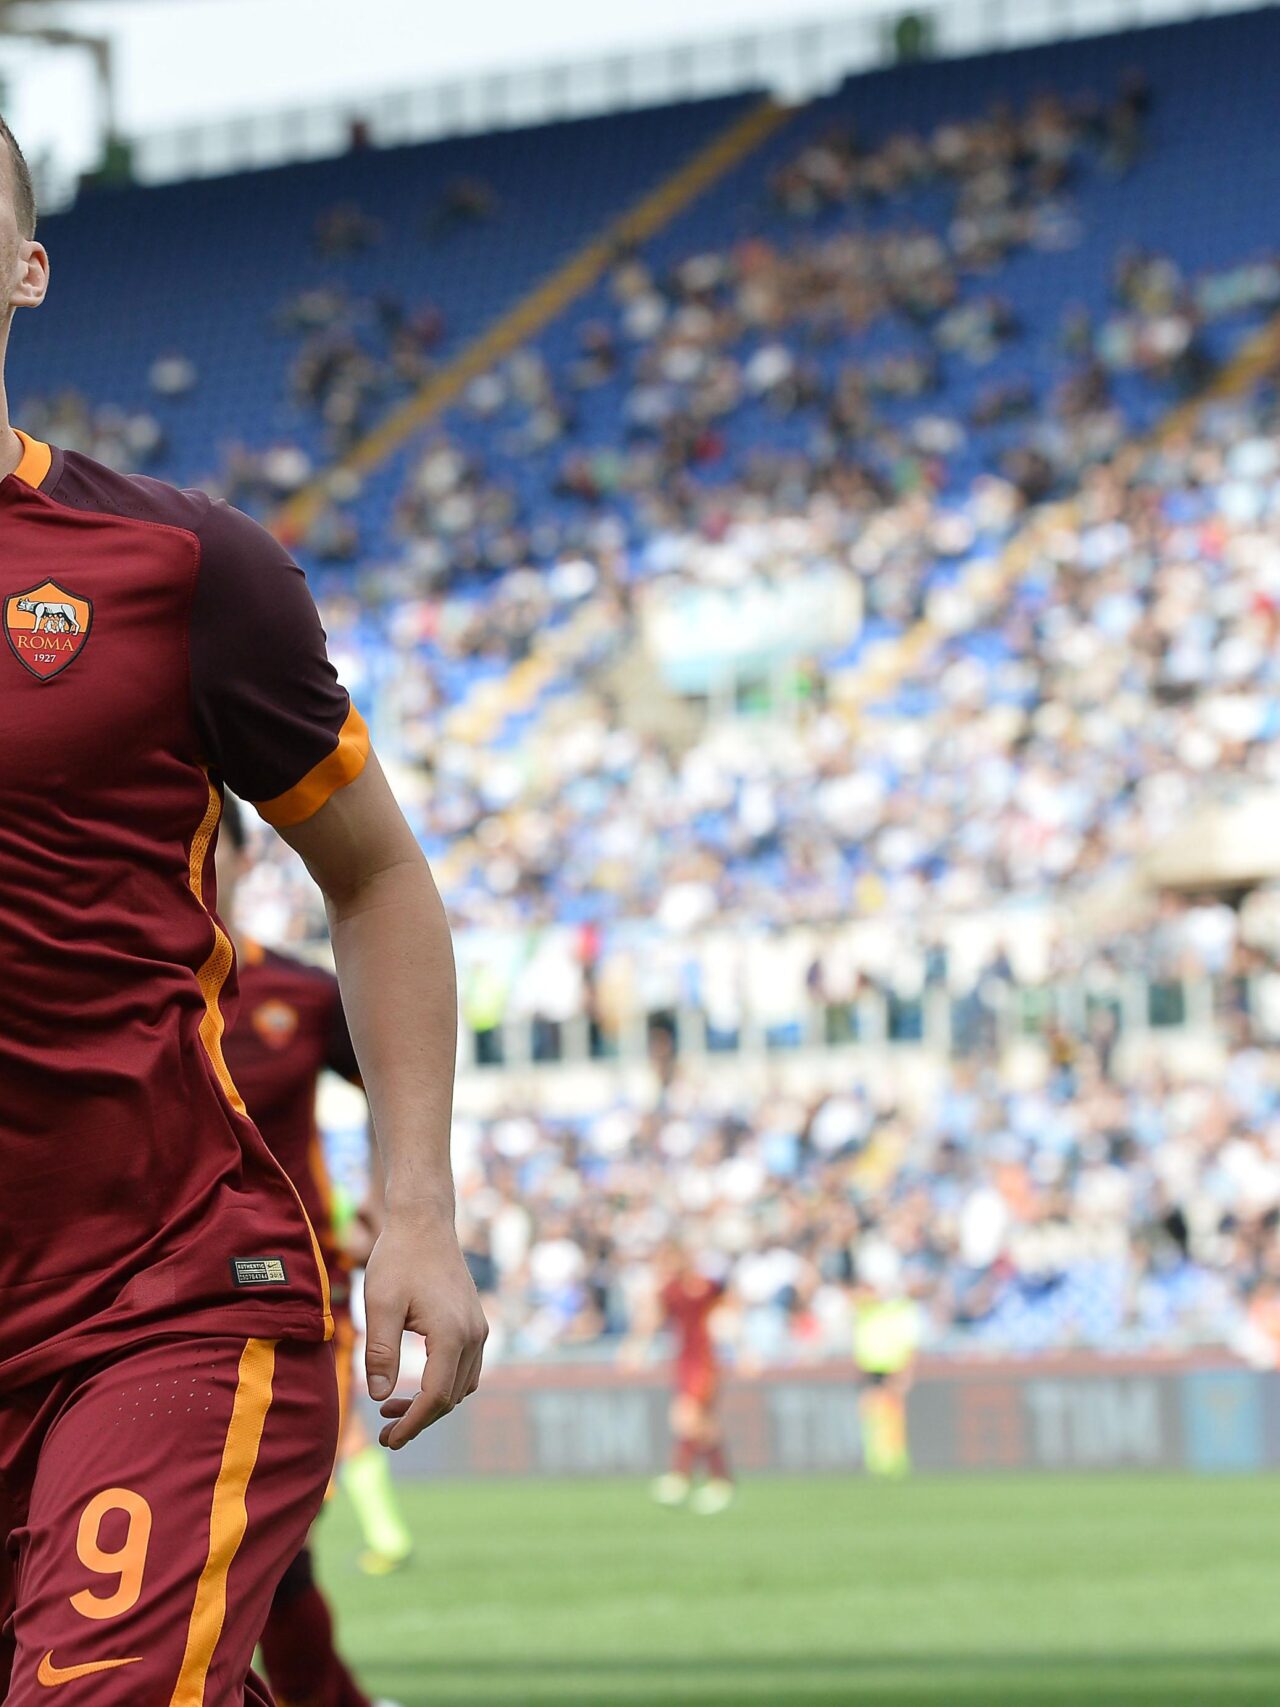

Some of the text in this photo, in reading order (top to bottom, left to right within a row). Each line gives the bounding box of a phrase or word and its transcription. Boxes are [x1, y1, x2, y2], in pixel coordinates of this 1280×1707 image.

[18, 636, 74, 651] ROMA
[34, 654, 56, 663] 1927
[70, 1487, 152, 1620] 9
